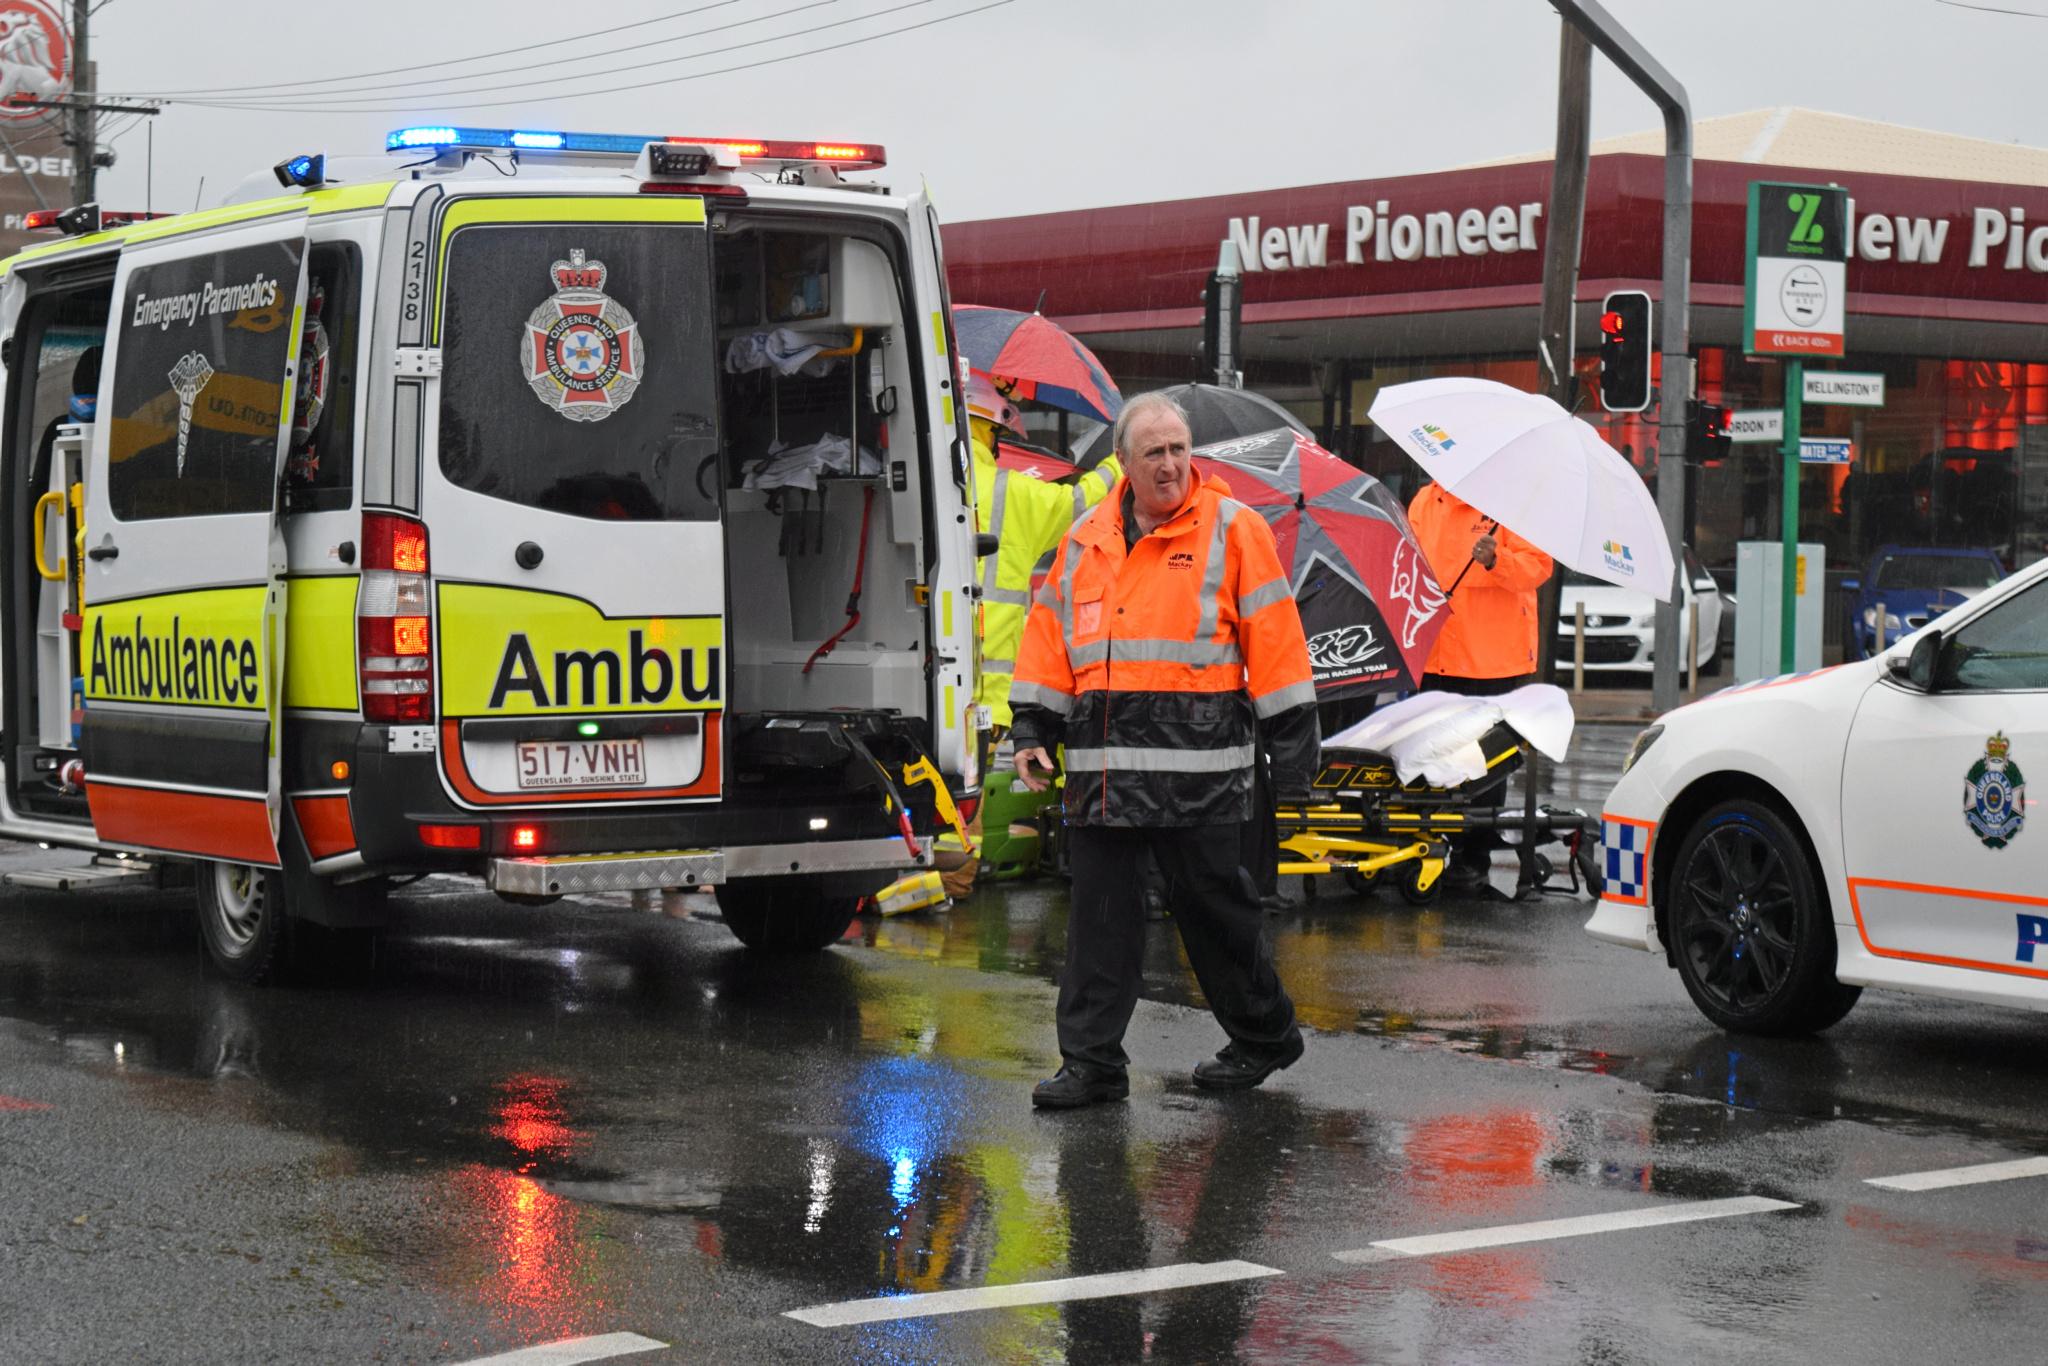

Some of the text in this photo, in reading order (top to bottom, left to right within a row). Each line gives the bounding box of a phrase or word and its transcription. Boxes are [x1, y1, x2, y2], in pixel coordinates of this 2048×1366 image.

[1229, 199, 1542, 273] New Pioneer
[404, 240, 425, 321] 2138
[132, 273, 277, 331] Emergency Paramedics
[550, 314, 614, 339] QUEENSLAND
[545, 348, 620, 390] AMBULANCE SERVICE
[1806, 381, 1870, 396] WELLINGTON
[1727, 420, 1764, 433] ORDON
[1410, 428, 1441, 456] Mackay
[1604, 553, 1634, 575] Mackay
[90, 614, 258, 703] Ambulance
[488, 629, 721, 708] Ambu
[1312, 663, 1388, 681] DEN RACING TEAM
[525, 774, 640, 785] QUEENSLAND SUNSHINE STATE
[1976, 772, 2011, 801] QUEENSLAND
[1982, 809, 2006, 823] POLICE
